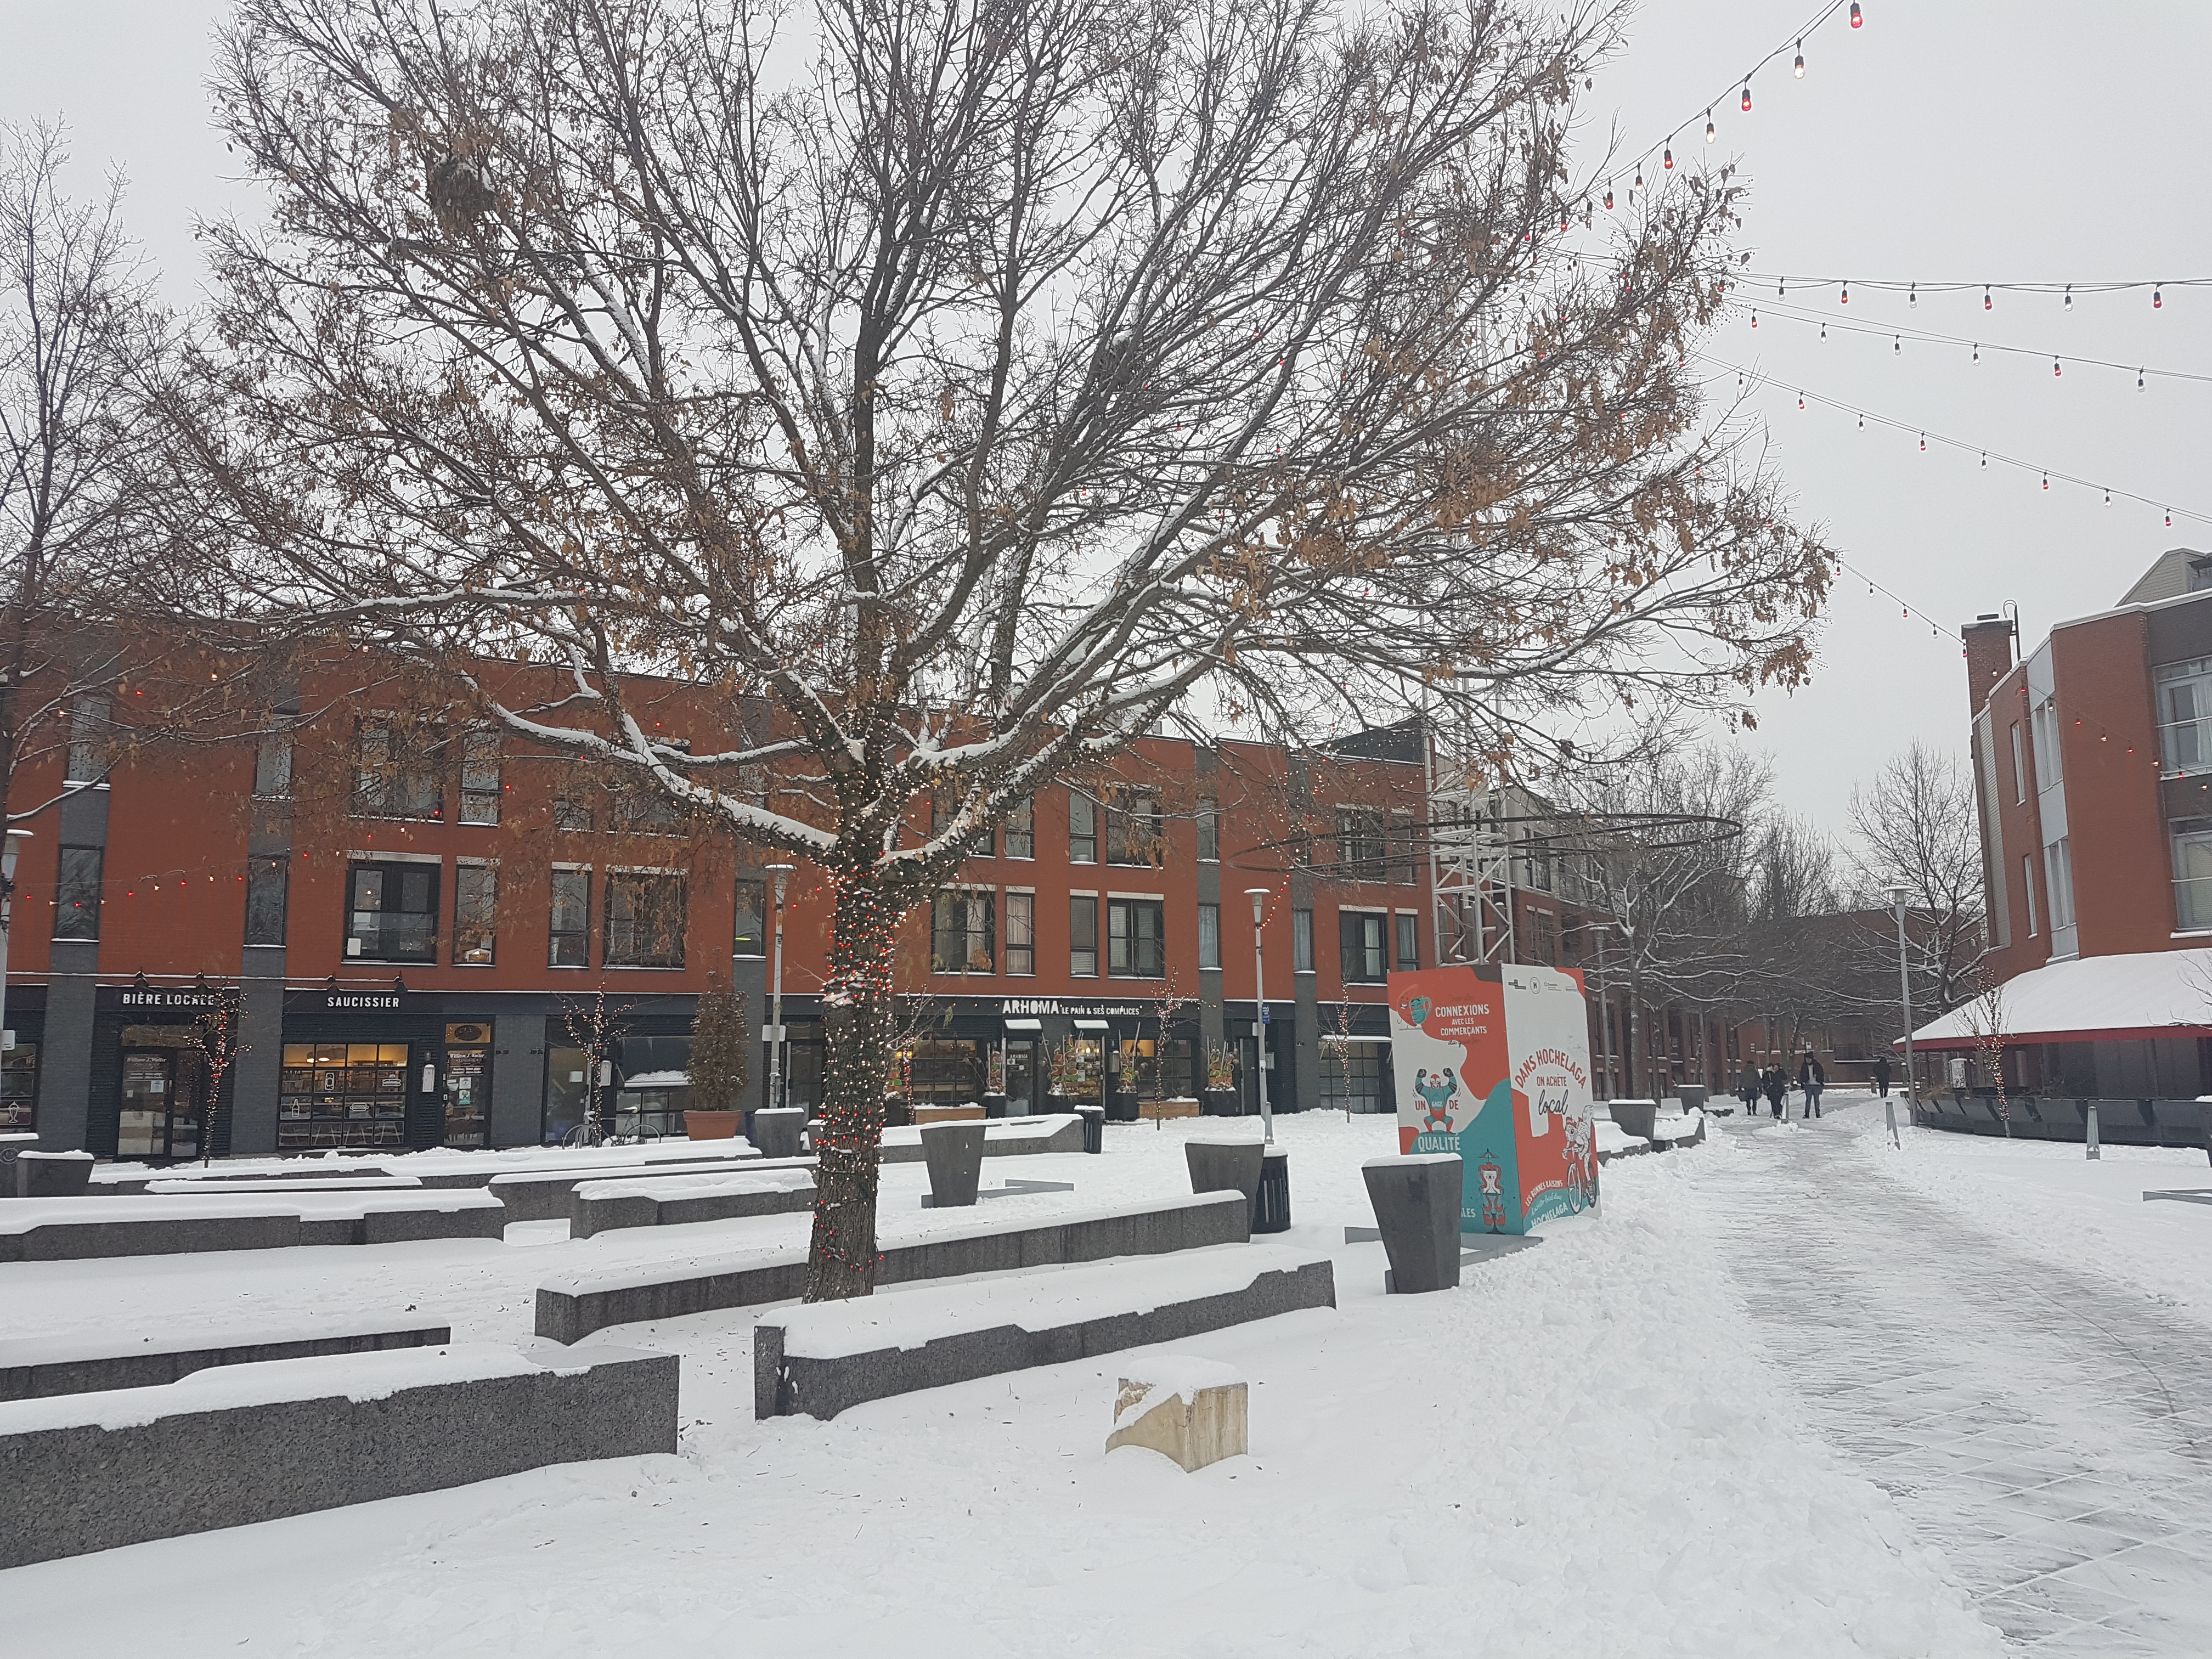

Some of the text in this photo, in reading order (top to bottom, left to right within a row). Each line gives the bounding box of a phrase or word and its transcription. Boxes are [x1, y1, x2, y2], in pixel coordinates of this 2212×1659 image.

[123, 992, 215, 1005] BIÈRE LOCALE
[327, 997, 399, 1007] SAUCISSIER
[1002, 1000, 1059, 1014] ARHOMA
[1435, 1004, 1490, 1018] CONNEXIONS
[1440, 1026, 1487, 1036] COMMERÇANTS
[1515, 1048, 1587, 1089] DANS HOCHELAGA
[1537, 1073, 1567, 1086] ON ACHÈTE
[1415, 1101, 1426, 1110] UN
[1449, 1100, 1459, 1110] DE
[1538, 1089, 1568, 1115] local
[1418, 1133, 1461, 1152] QUALITÉ
[1531, 1202, 1568, 1227] HOCHELAGA
